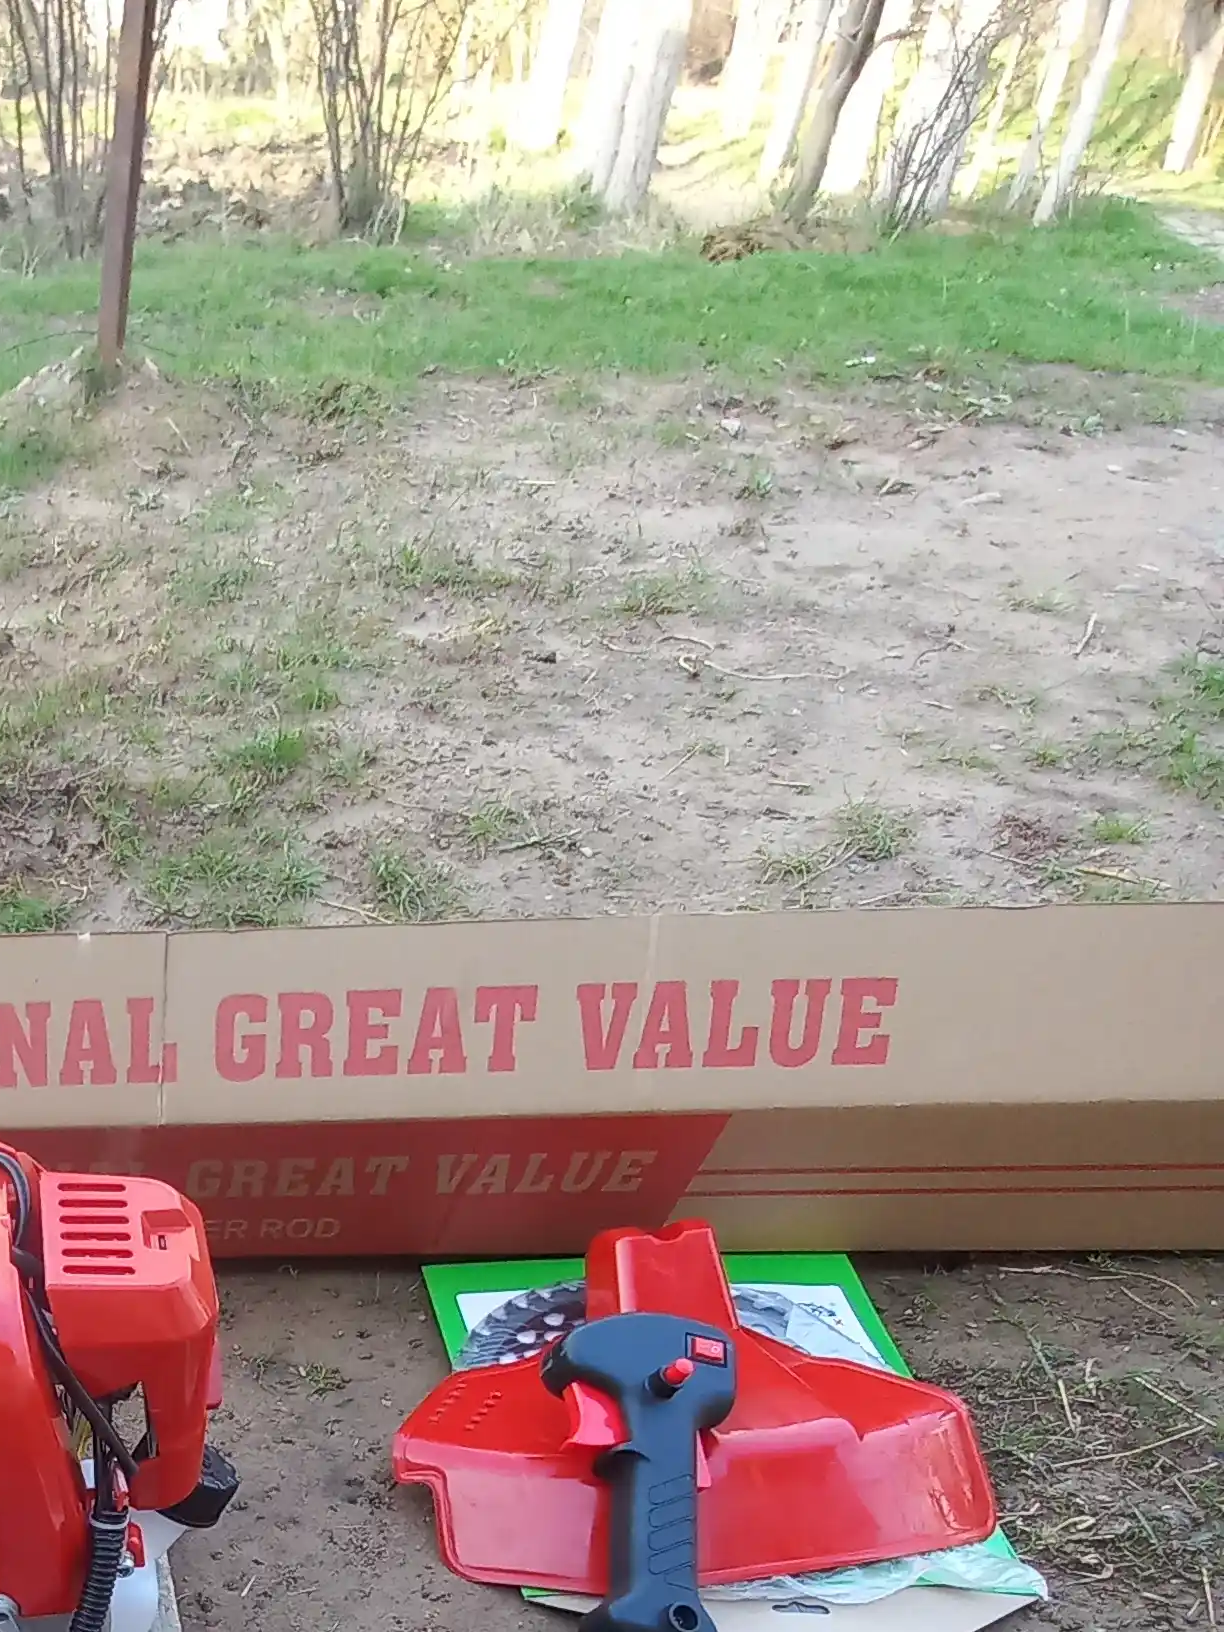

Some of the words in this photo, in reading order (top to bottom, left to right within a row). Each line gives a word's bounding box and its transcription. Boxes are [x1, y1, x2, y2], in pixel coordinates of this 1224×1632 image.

[215, 984, 538, 1083] GREAT
[577, 977, 899, 1071] VALUE
[185, 1155, 409, 1199] GREAT
[435, 1150, 658, 1197] VALUE
[260, 1217, 341, 1239] ROD
